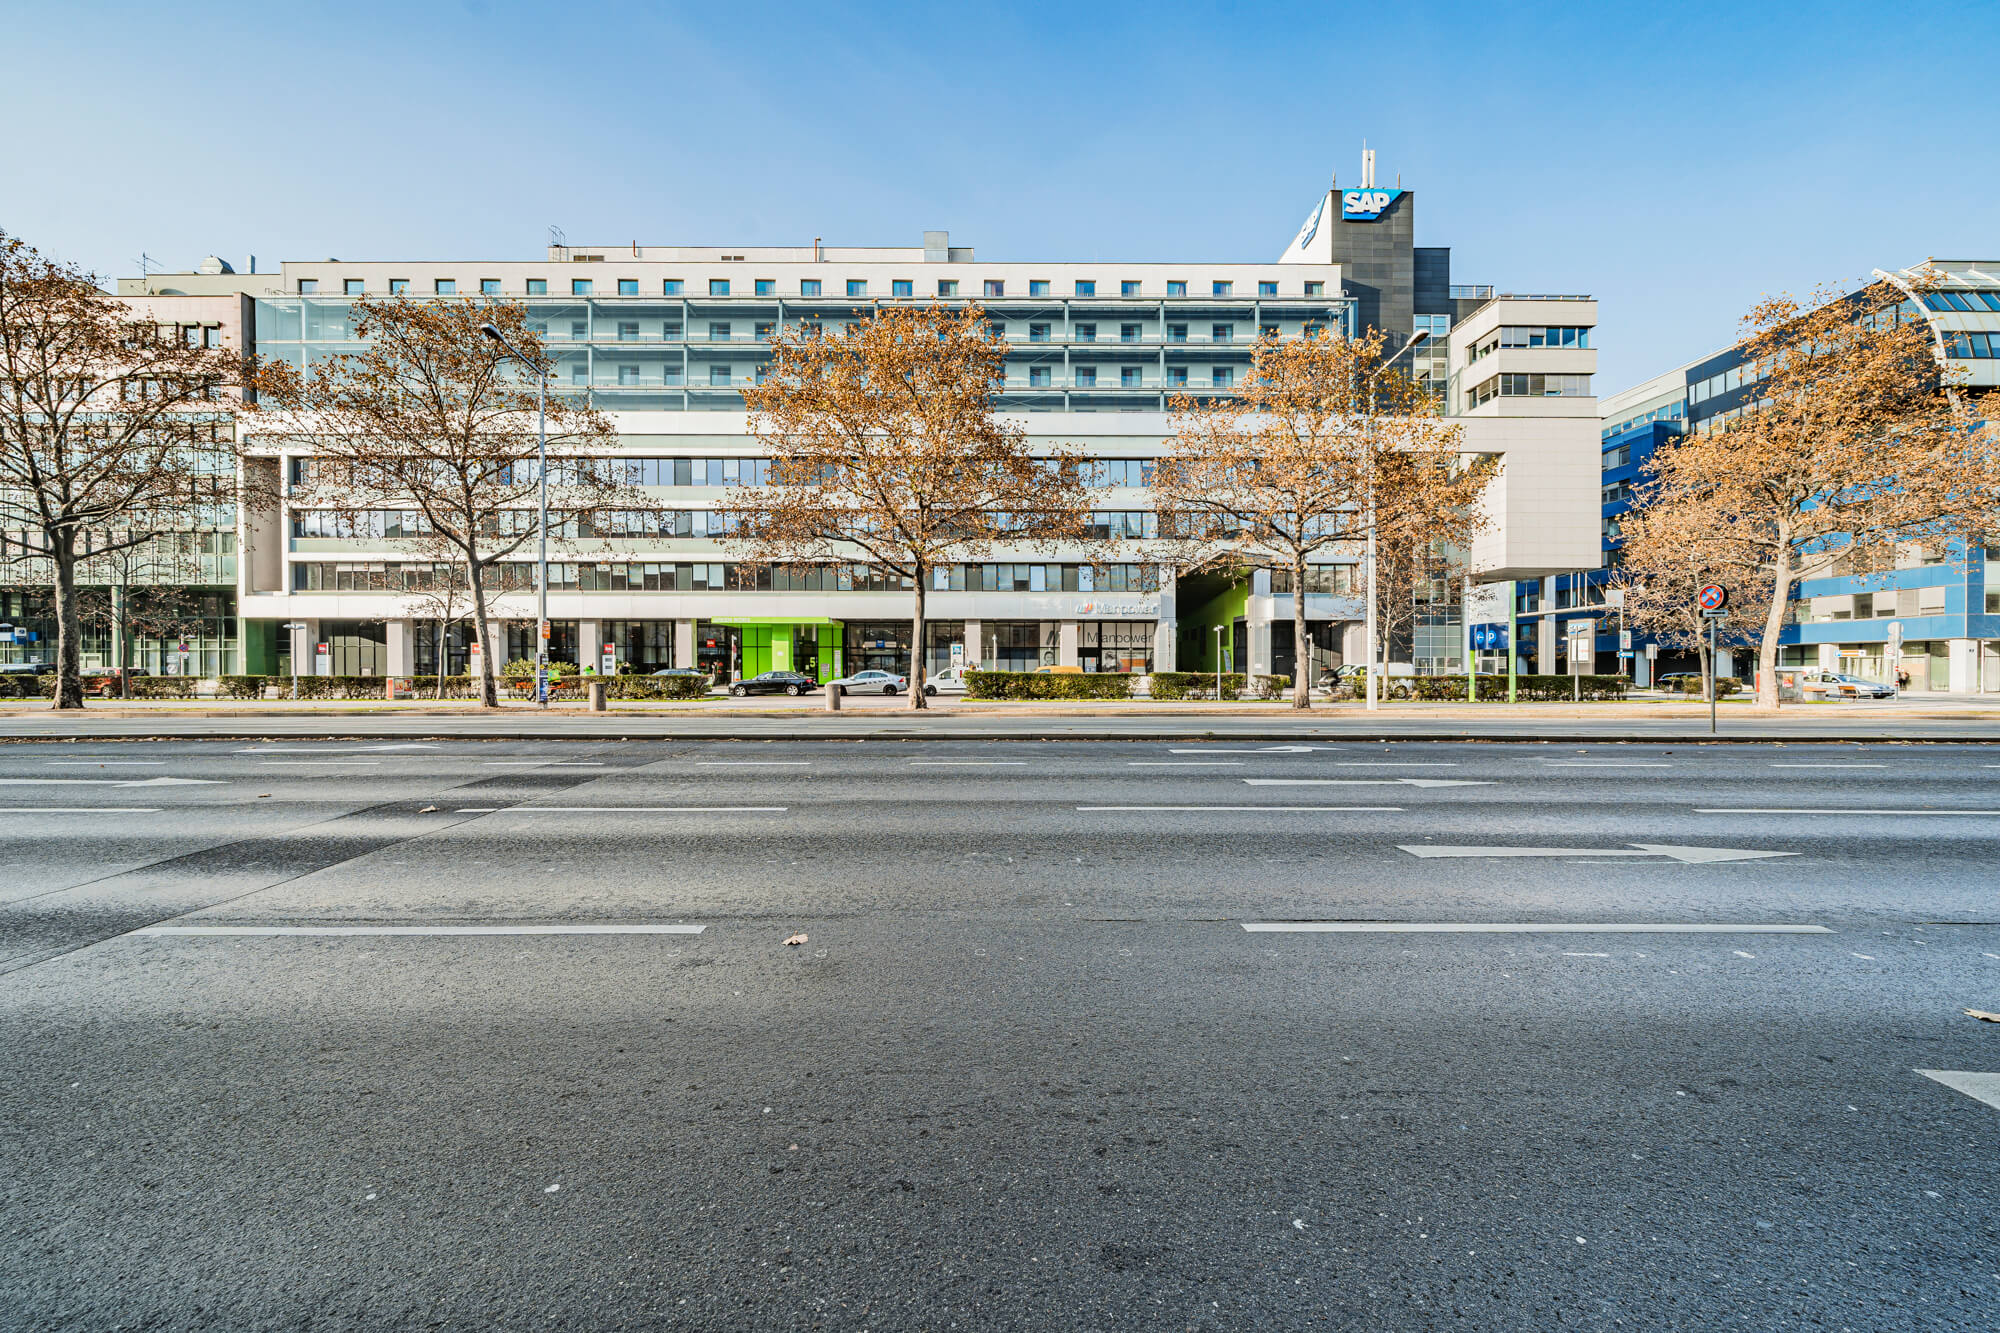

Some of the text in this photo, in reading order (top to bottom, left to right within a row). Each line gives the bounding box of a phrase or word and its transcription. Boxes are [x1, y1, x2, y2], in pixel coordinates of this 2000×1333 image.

[1344, 192, 1390, 213] SAP
[1096, 603, 1159, 615] Manpower
[810, 656, 816, 668] 5
